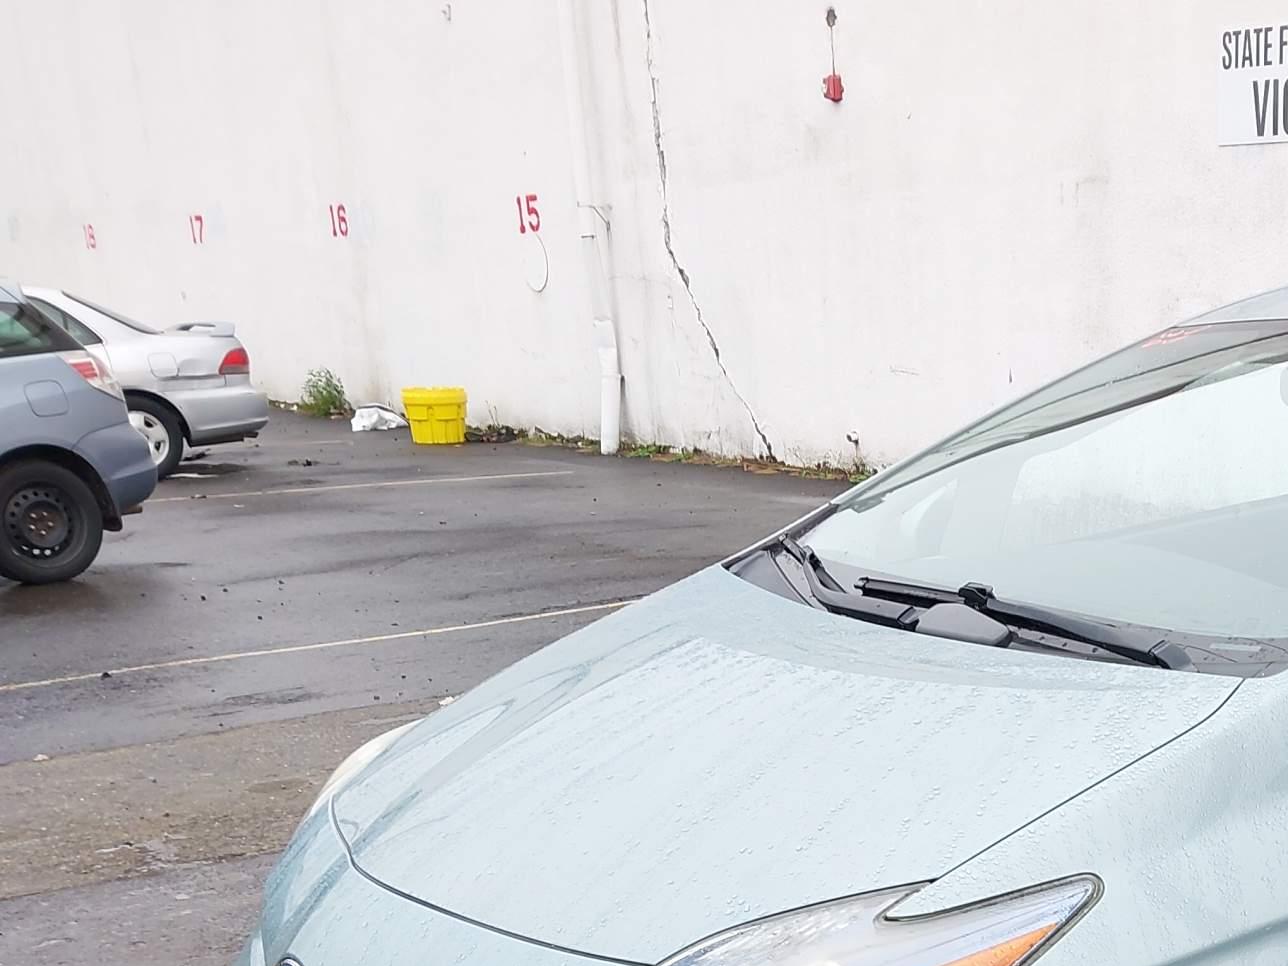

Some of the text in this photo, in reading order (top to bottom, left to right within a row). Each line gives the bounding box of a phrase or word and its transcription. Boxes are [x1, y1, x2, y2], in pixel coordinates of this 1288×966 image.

[1222, 27, 1273, 69] STATE
[189, 215, 203, 244] 17
[329, 203, 348, 237] 16
[517, 194, 540, 233] 15
